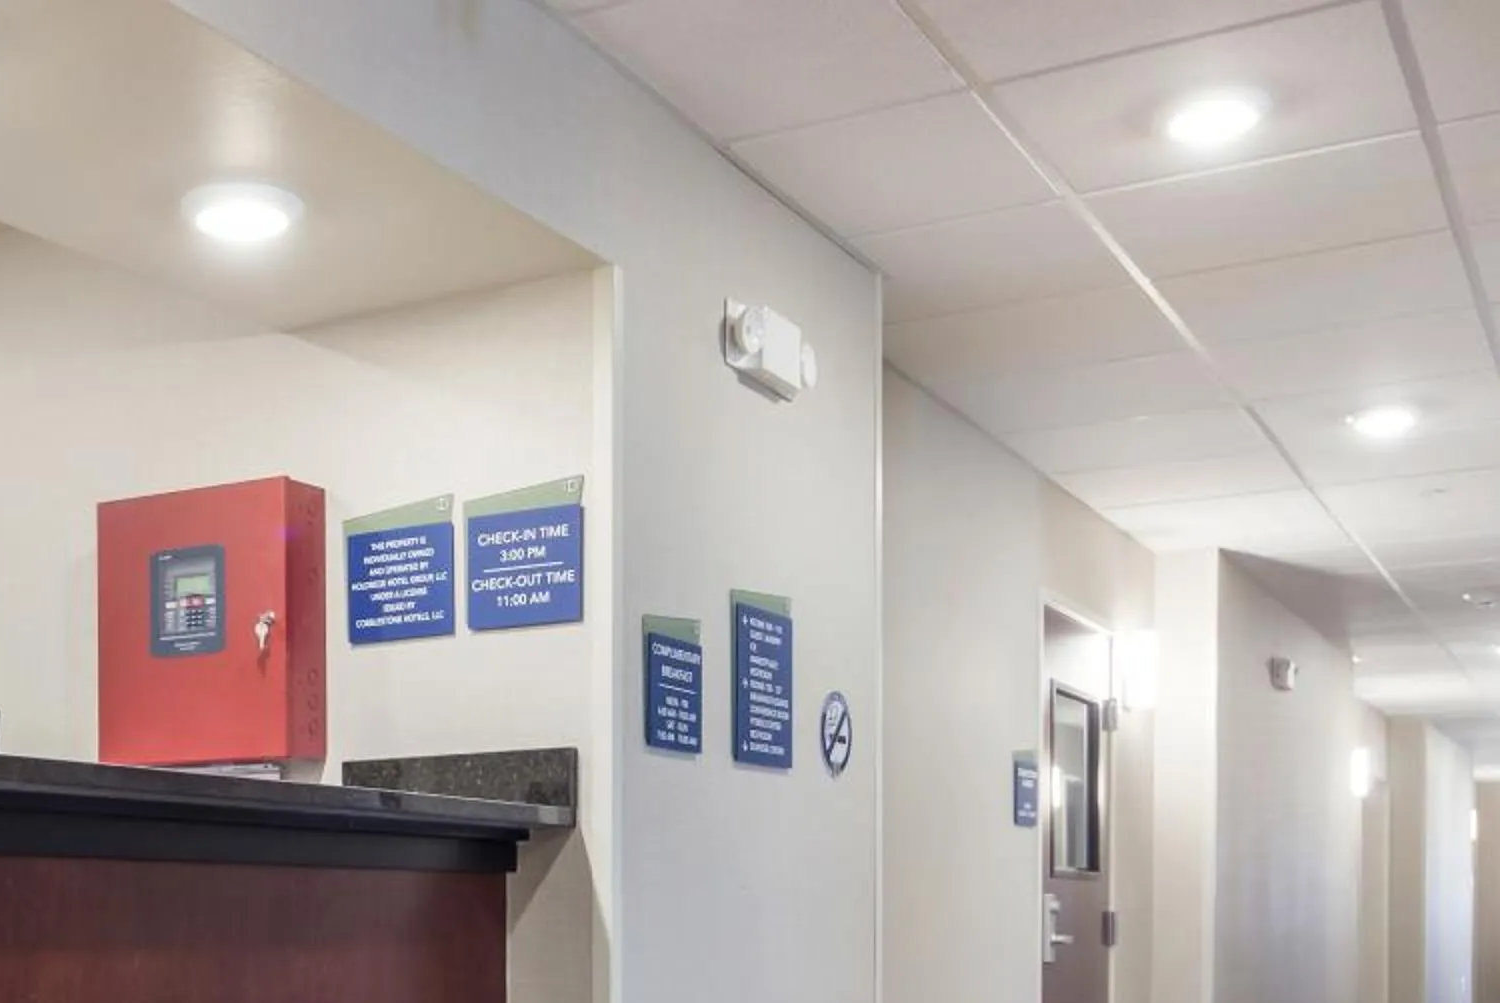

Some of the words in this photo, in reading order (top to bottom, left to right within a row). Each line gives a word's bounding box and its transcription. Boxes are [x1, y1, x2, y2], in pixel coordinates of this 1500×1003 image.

[386, 537, 419, 549] PROPERTY
[477, 528, 536, 546] CHECK-IN
[540, 524, 569, 539] TIME
[500, 547, 525, 562] 3:00
[527, 545, 546, 559] PM
[369, 566, 384, 577] AND
[472, 573, 542, 592] CHECK-OUT
[546, 569, 575, 584] TIME
[497, 593, 527, 607] 11:00
[530, 591, 551, 605] AM
